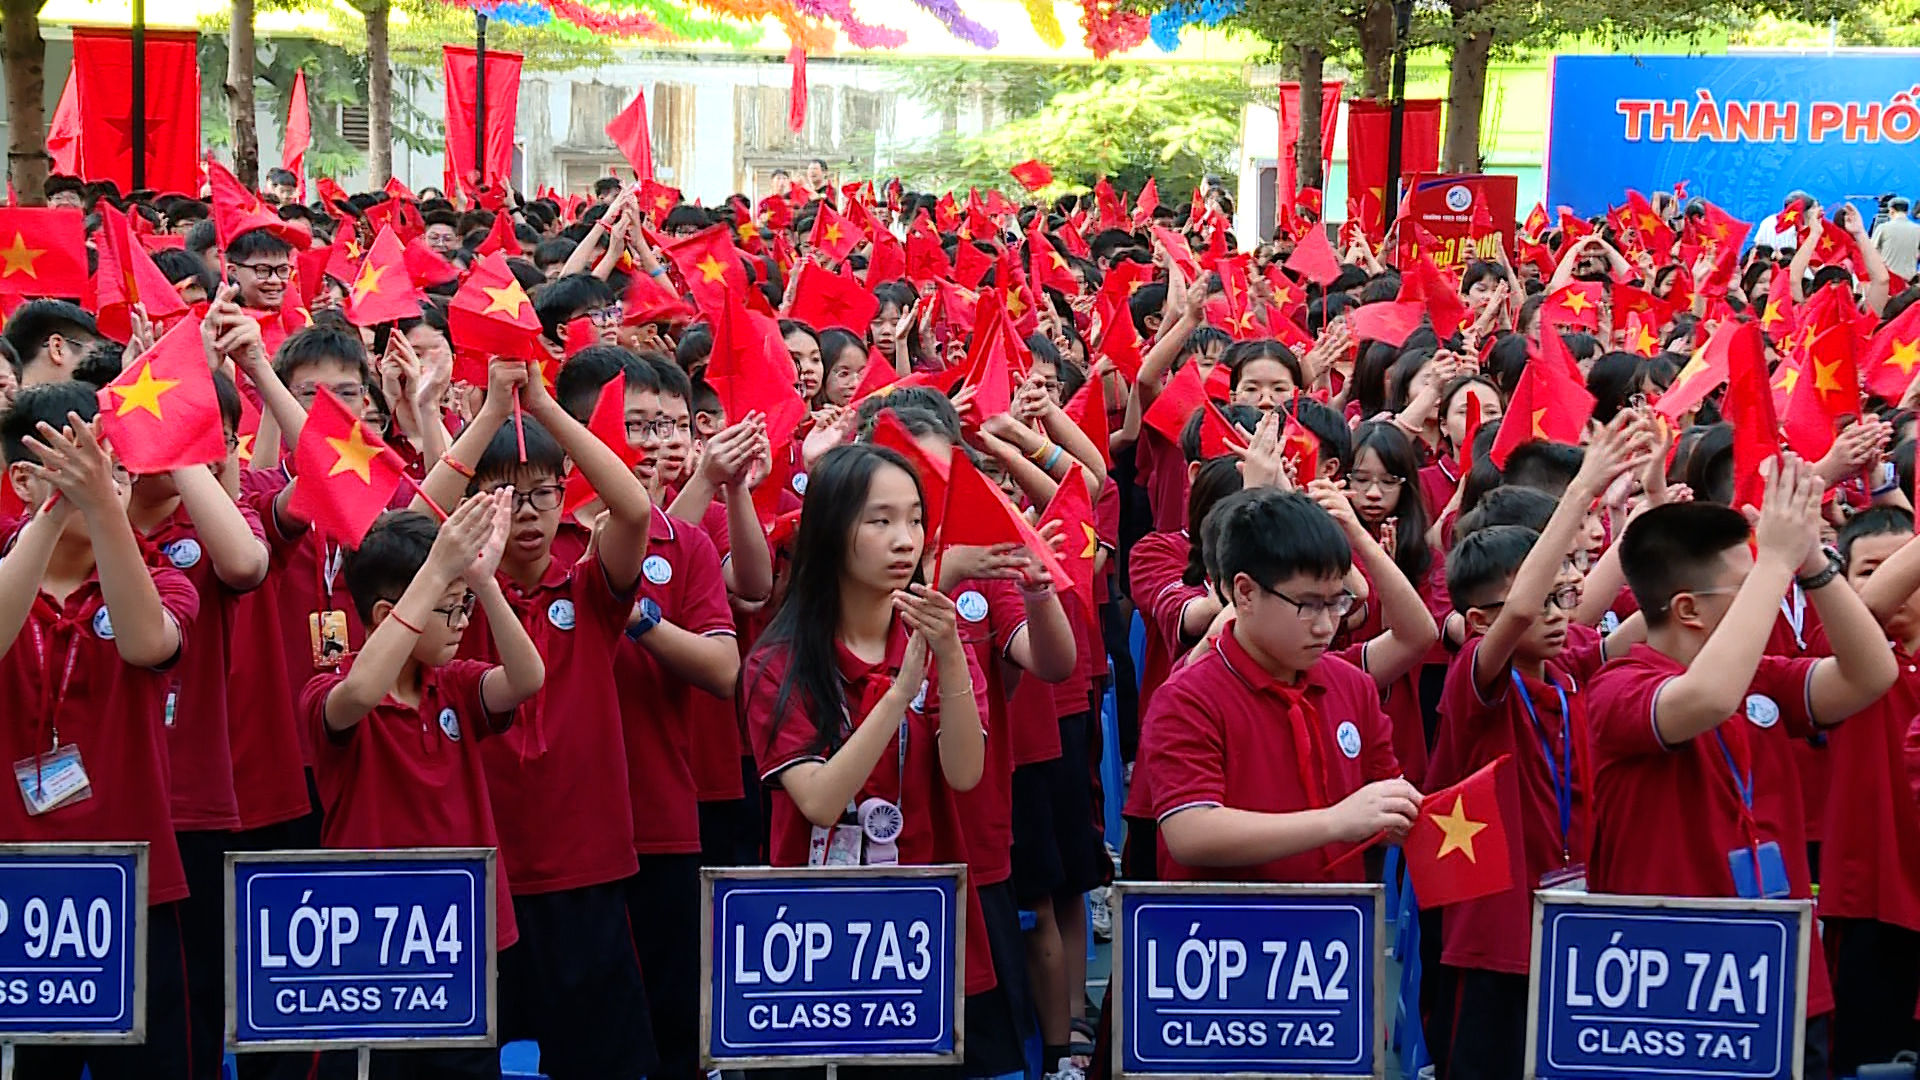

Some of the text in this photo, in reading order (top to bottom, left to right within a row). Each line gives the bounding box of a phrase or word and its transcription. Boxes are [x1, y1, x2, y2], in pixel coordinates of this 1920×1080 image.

[1617, 90, 1797, 142] THÀNH
[24, 897, 112, 958] 9A0
[260, 889, 463, 968] LỚP 7A4
[735, 905, 932, 984] LỚP 7A3
[1147, 922, 1350, 1001] LỚP 7A2
[1566, 931, 1769, 1015] LỚP 7A1
[38, 979, 97, 1004] 9A0
[275, 985, 448, 1014] CLASS 7A4
[749, 1001, 917, 1030] CLASS 7A3
[1162, 1021, 1335, 1047] CLASS 7A2
[1577, 1028, 1752, 1060] CLASS 7A1
